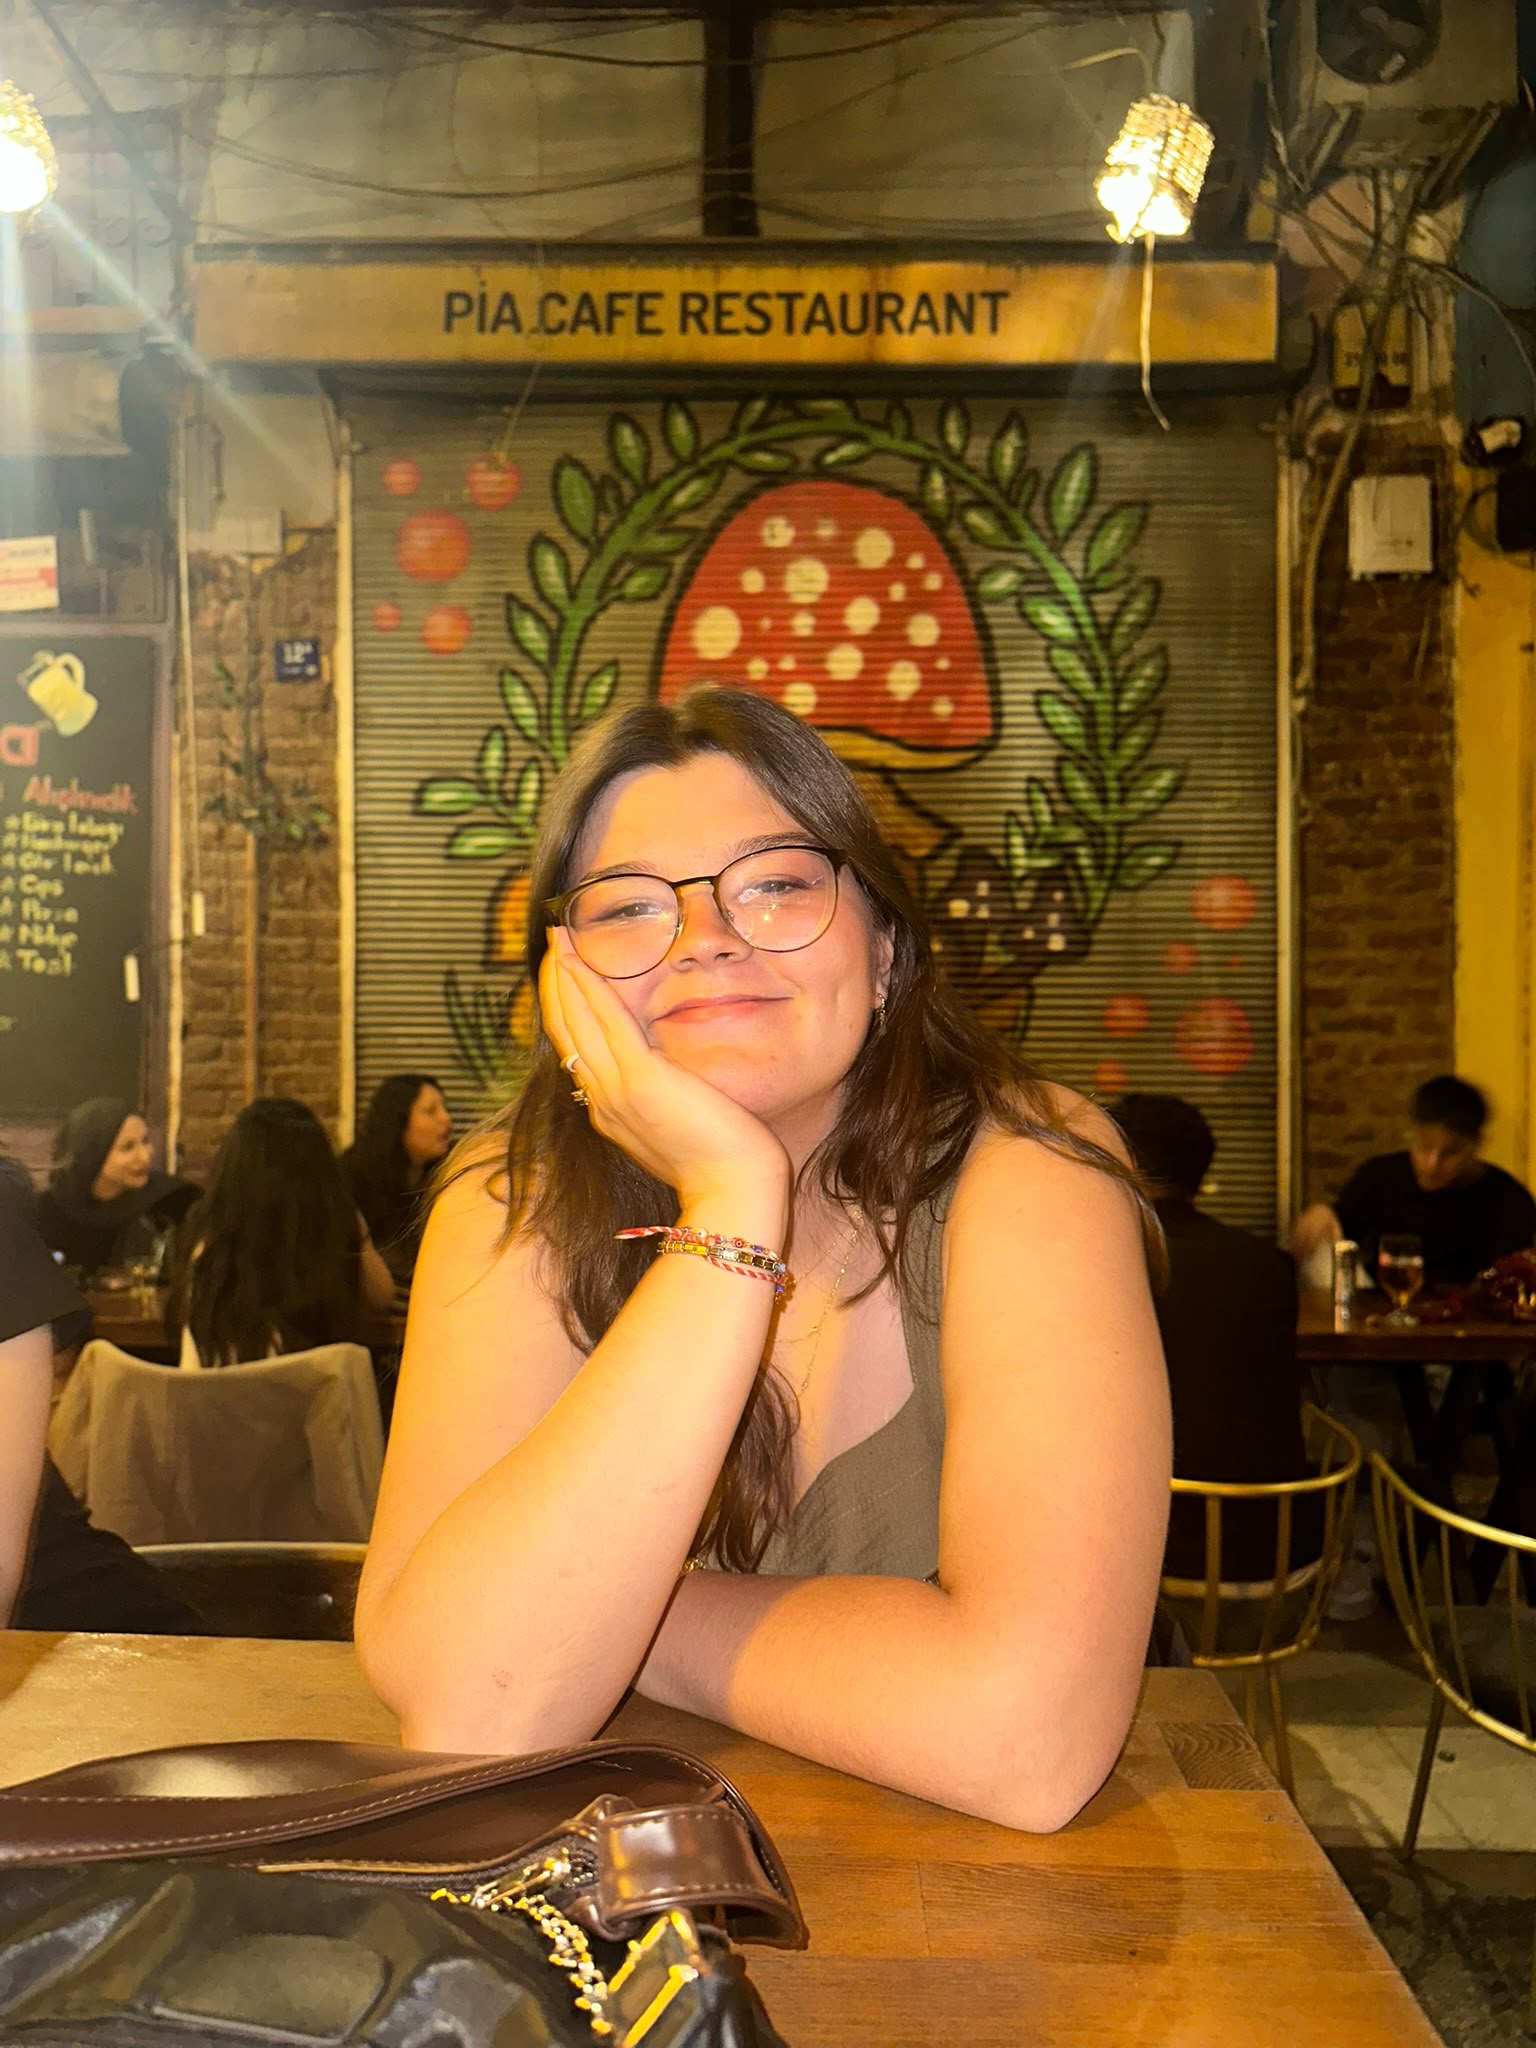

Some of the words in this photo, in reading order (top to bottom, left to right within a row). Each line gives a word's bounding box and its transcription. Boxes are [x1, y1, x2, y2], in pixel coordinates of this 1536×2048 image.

[442, 280, 523, 334] PİA
[537, 290, 665, 335] CAFE
[677, 291, 1010, 335] RESTAURANT
